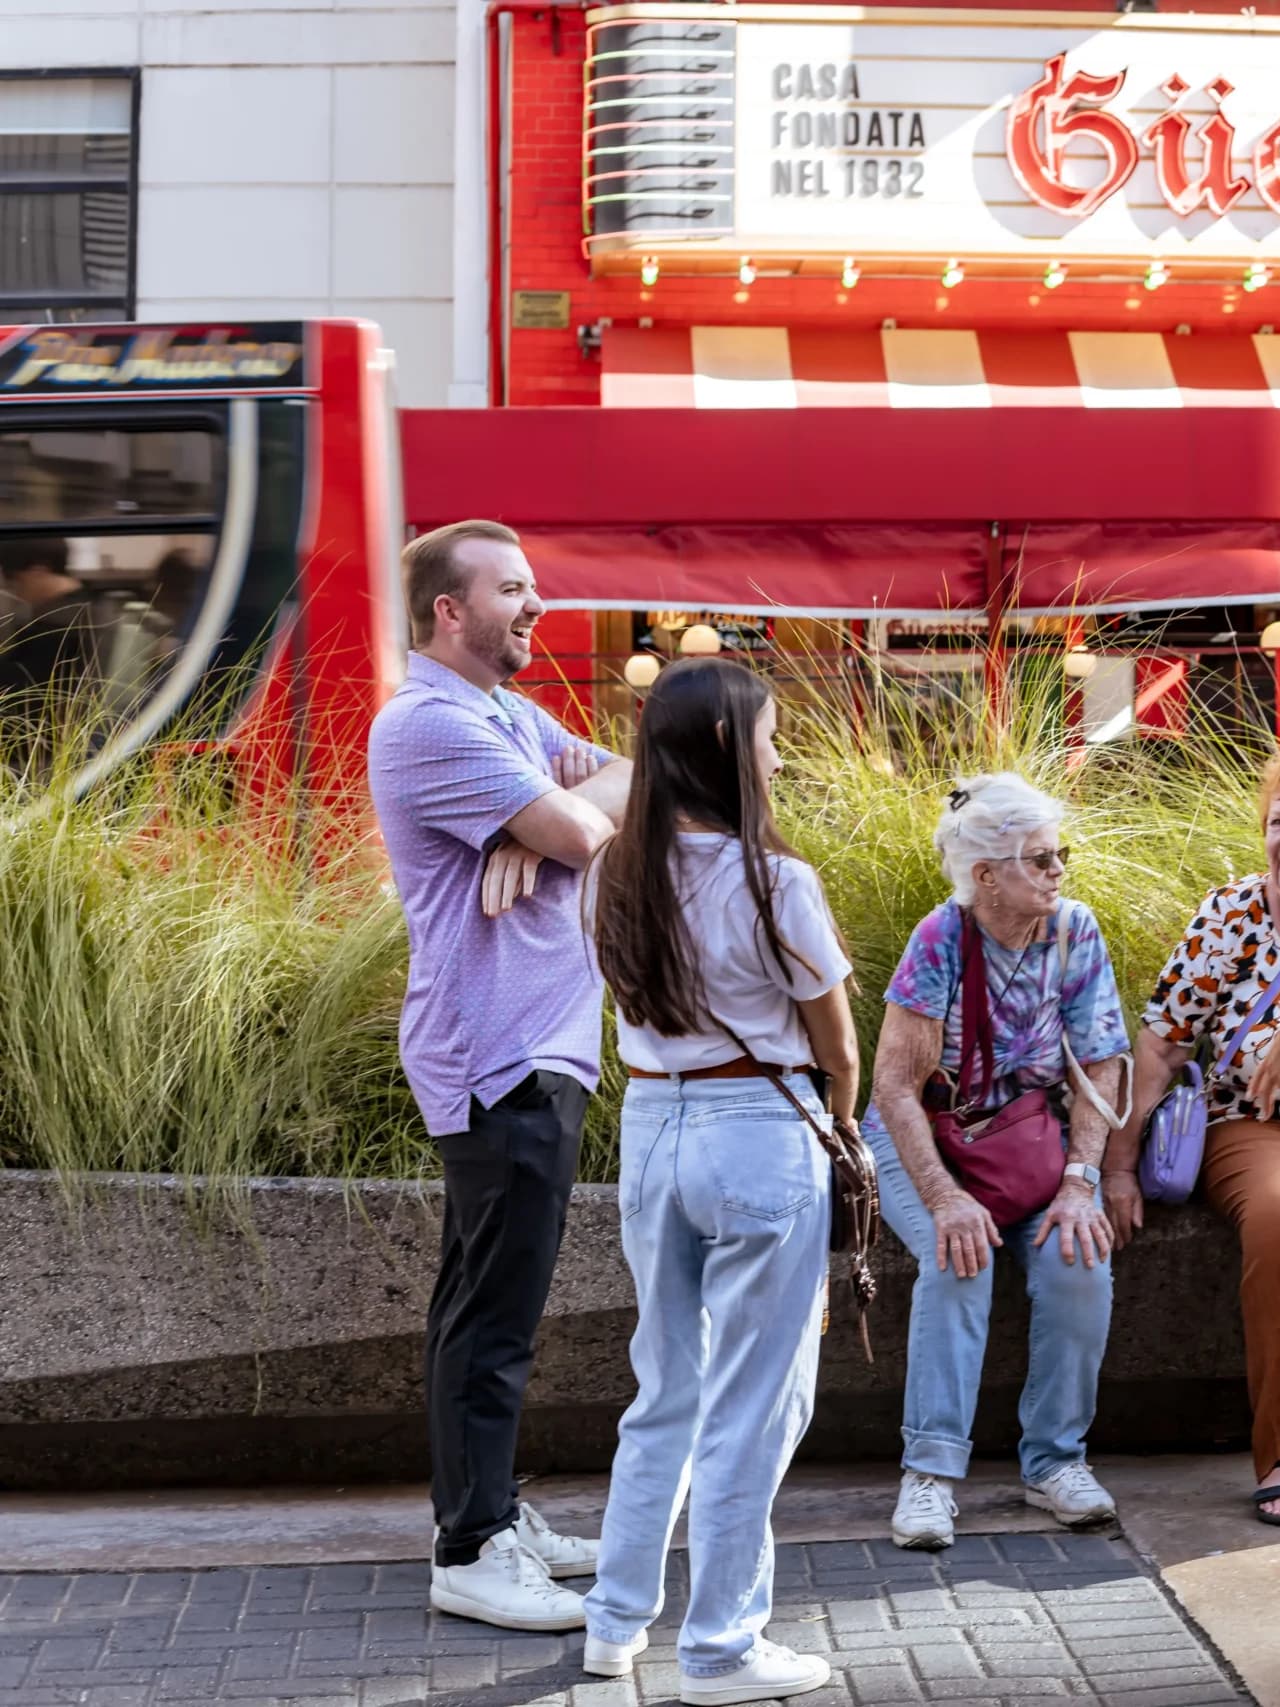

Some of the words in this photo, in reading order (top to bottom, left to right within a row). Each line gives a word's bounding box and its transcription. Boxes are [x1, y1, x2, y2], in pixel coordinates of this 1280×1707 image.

[771, 62, 860, 101] CASA
[771, 110, 926, 149] FONDATA
[771, 158, 831, 198] NEL
[843, 158, 925, 199] 1932
